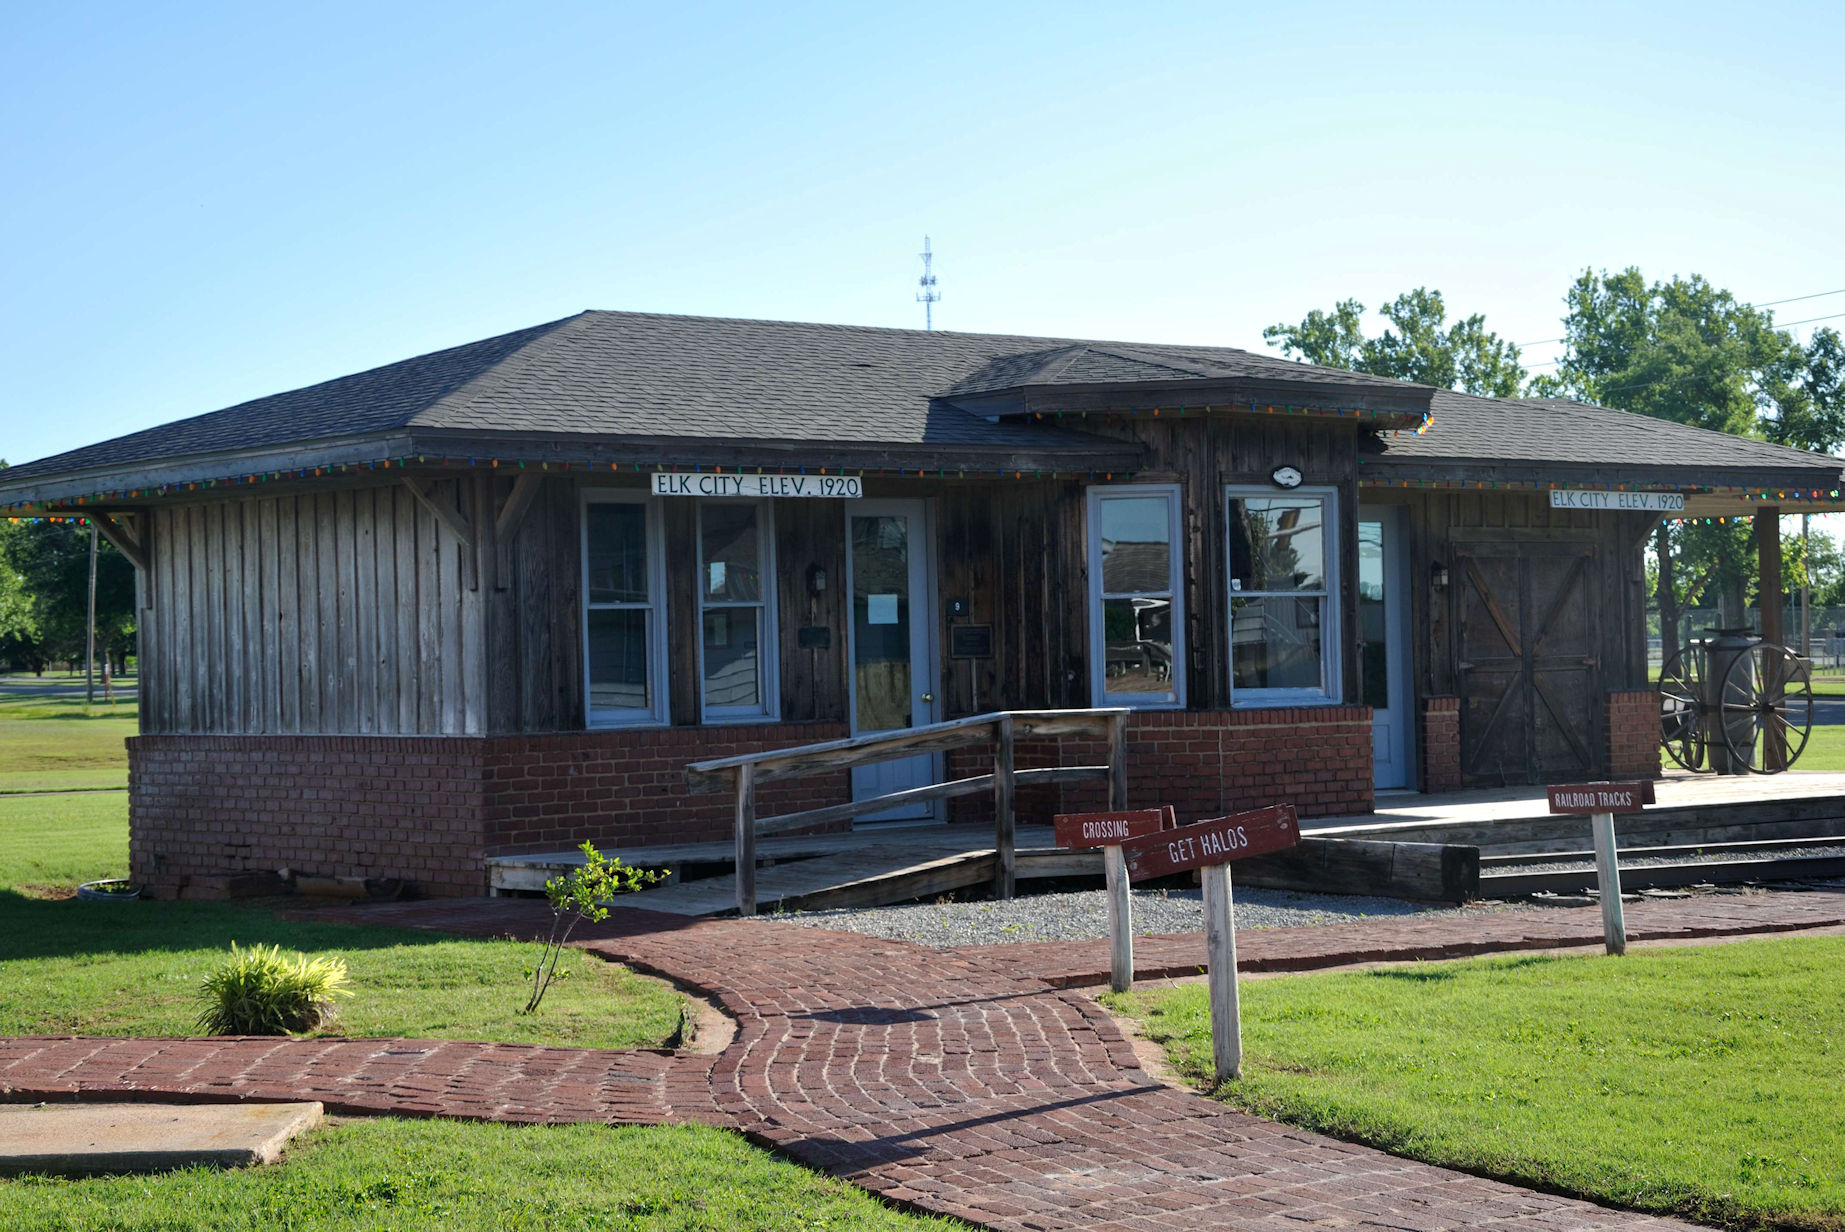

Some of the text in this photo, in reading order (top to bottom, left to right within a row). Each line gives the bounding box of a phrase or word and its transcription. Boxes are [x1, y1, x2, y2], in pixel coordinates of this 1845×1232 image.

[658, 475, 858, 496] ELK CITY ELEV. 1920
[1552, 491, 1683, 509] ELK CITY ELEV. 1920
[1555, 791, 1632, 808] RAILROAD TRACKS
[1082, 820, 1129, 839] CROSSING
[1168, 826, 1248, 864] GET HALOS
